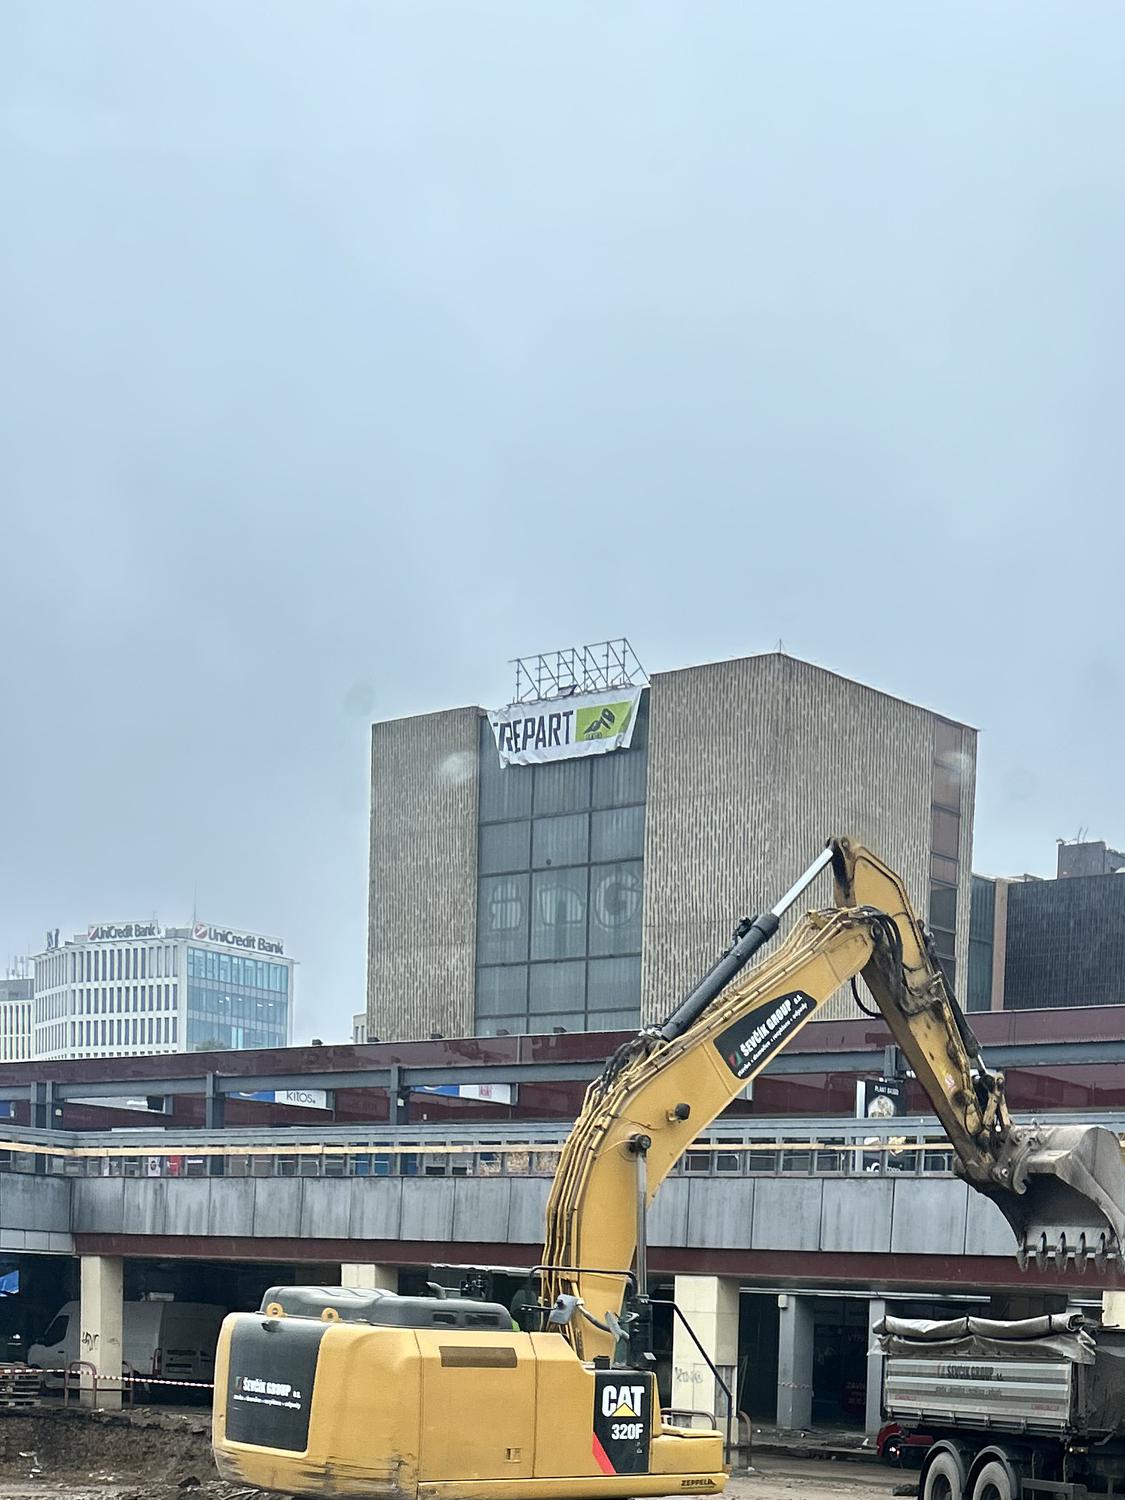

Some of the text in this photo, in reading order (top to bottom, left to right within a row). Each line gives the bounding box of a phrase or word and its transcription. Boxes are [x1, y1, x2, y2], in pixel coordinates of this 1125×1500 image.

[96, 923, 156, 940] UniCredit Bank
[208, 926, 284, 955] UniCredit Bank
[765, 999, 792, 1031] GROUP
[601, 1384, 646, 1418] CAT
[611, 1423, 644, 1440] 320F
